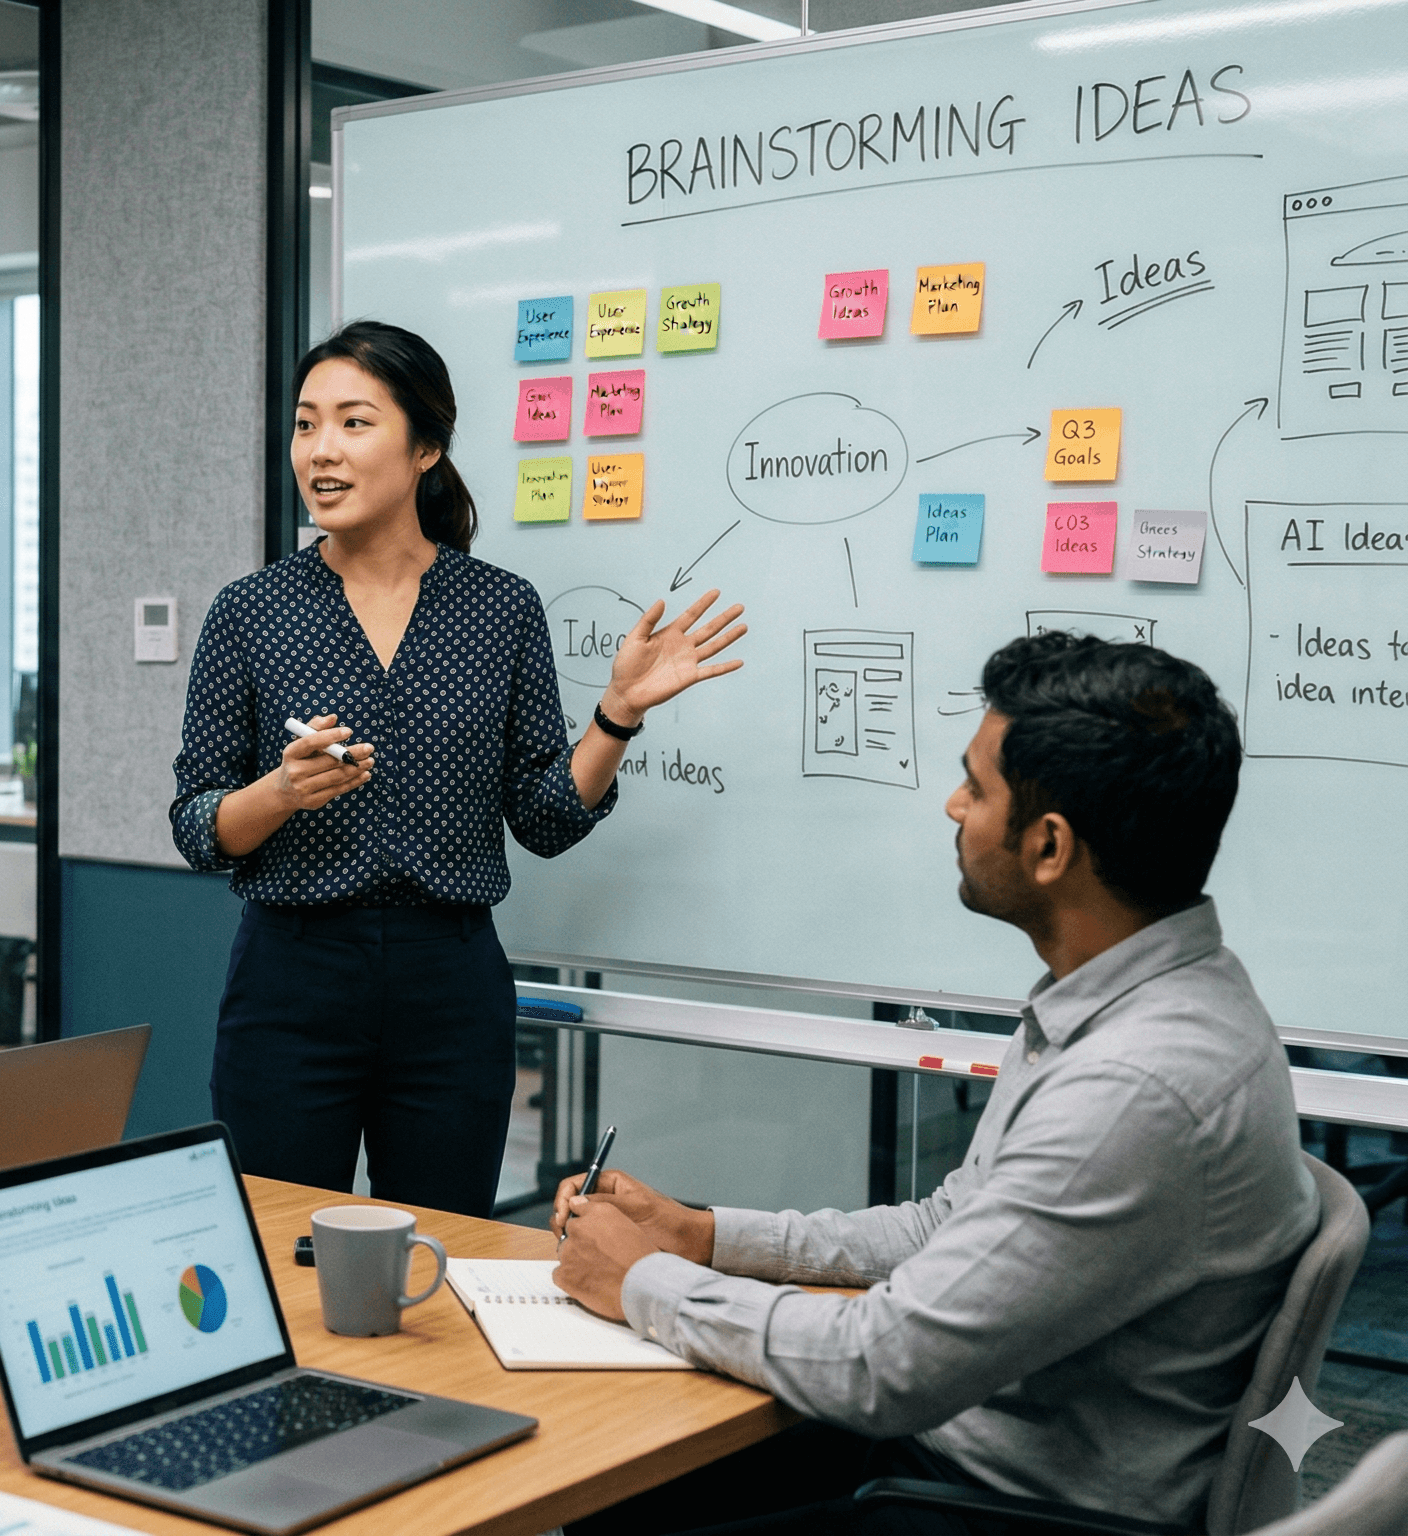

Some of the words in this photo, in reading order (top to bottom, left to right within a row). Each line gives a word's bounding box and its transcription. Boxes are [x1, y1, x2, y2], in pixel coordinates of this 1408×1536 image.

[627, 95, 1026, 205] BRAINSTORMING
[1074, 64, 1252, 144] IDEAS
[1094, 250, 1207, 305] Ideas
[830, 280, 879, 299] Growth
[526, 308, 556, 323] User
[832, 305, 869, 319] Ideas
[1062, 419, 1096, 439] Q3
[745, 437, 887, 480] Innovation
[1054, 447, 1101, 465] Goals
[927, 504, 967, 519] Ideas
[926, 526, 958, 543] Plan
[1281, 519, 1324, 551] AI
[1345, 522, 1408, 551] Idea
[1055, 538, 1098, 553] Ideas
[1298, 623, 1371, 660] Ideas
[1276, 673, 1335, 704] idea
[1352, 680, 1408, 708] inte
[619, 751, 648, 777] nd
[662, 748, 725, 794] ideas
